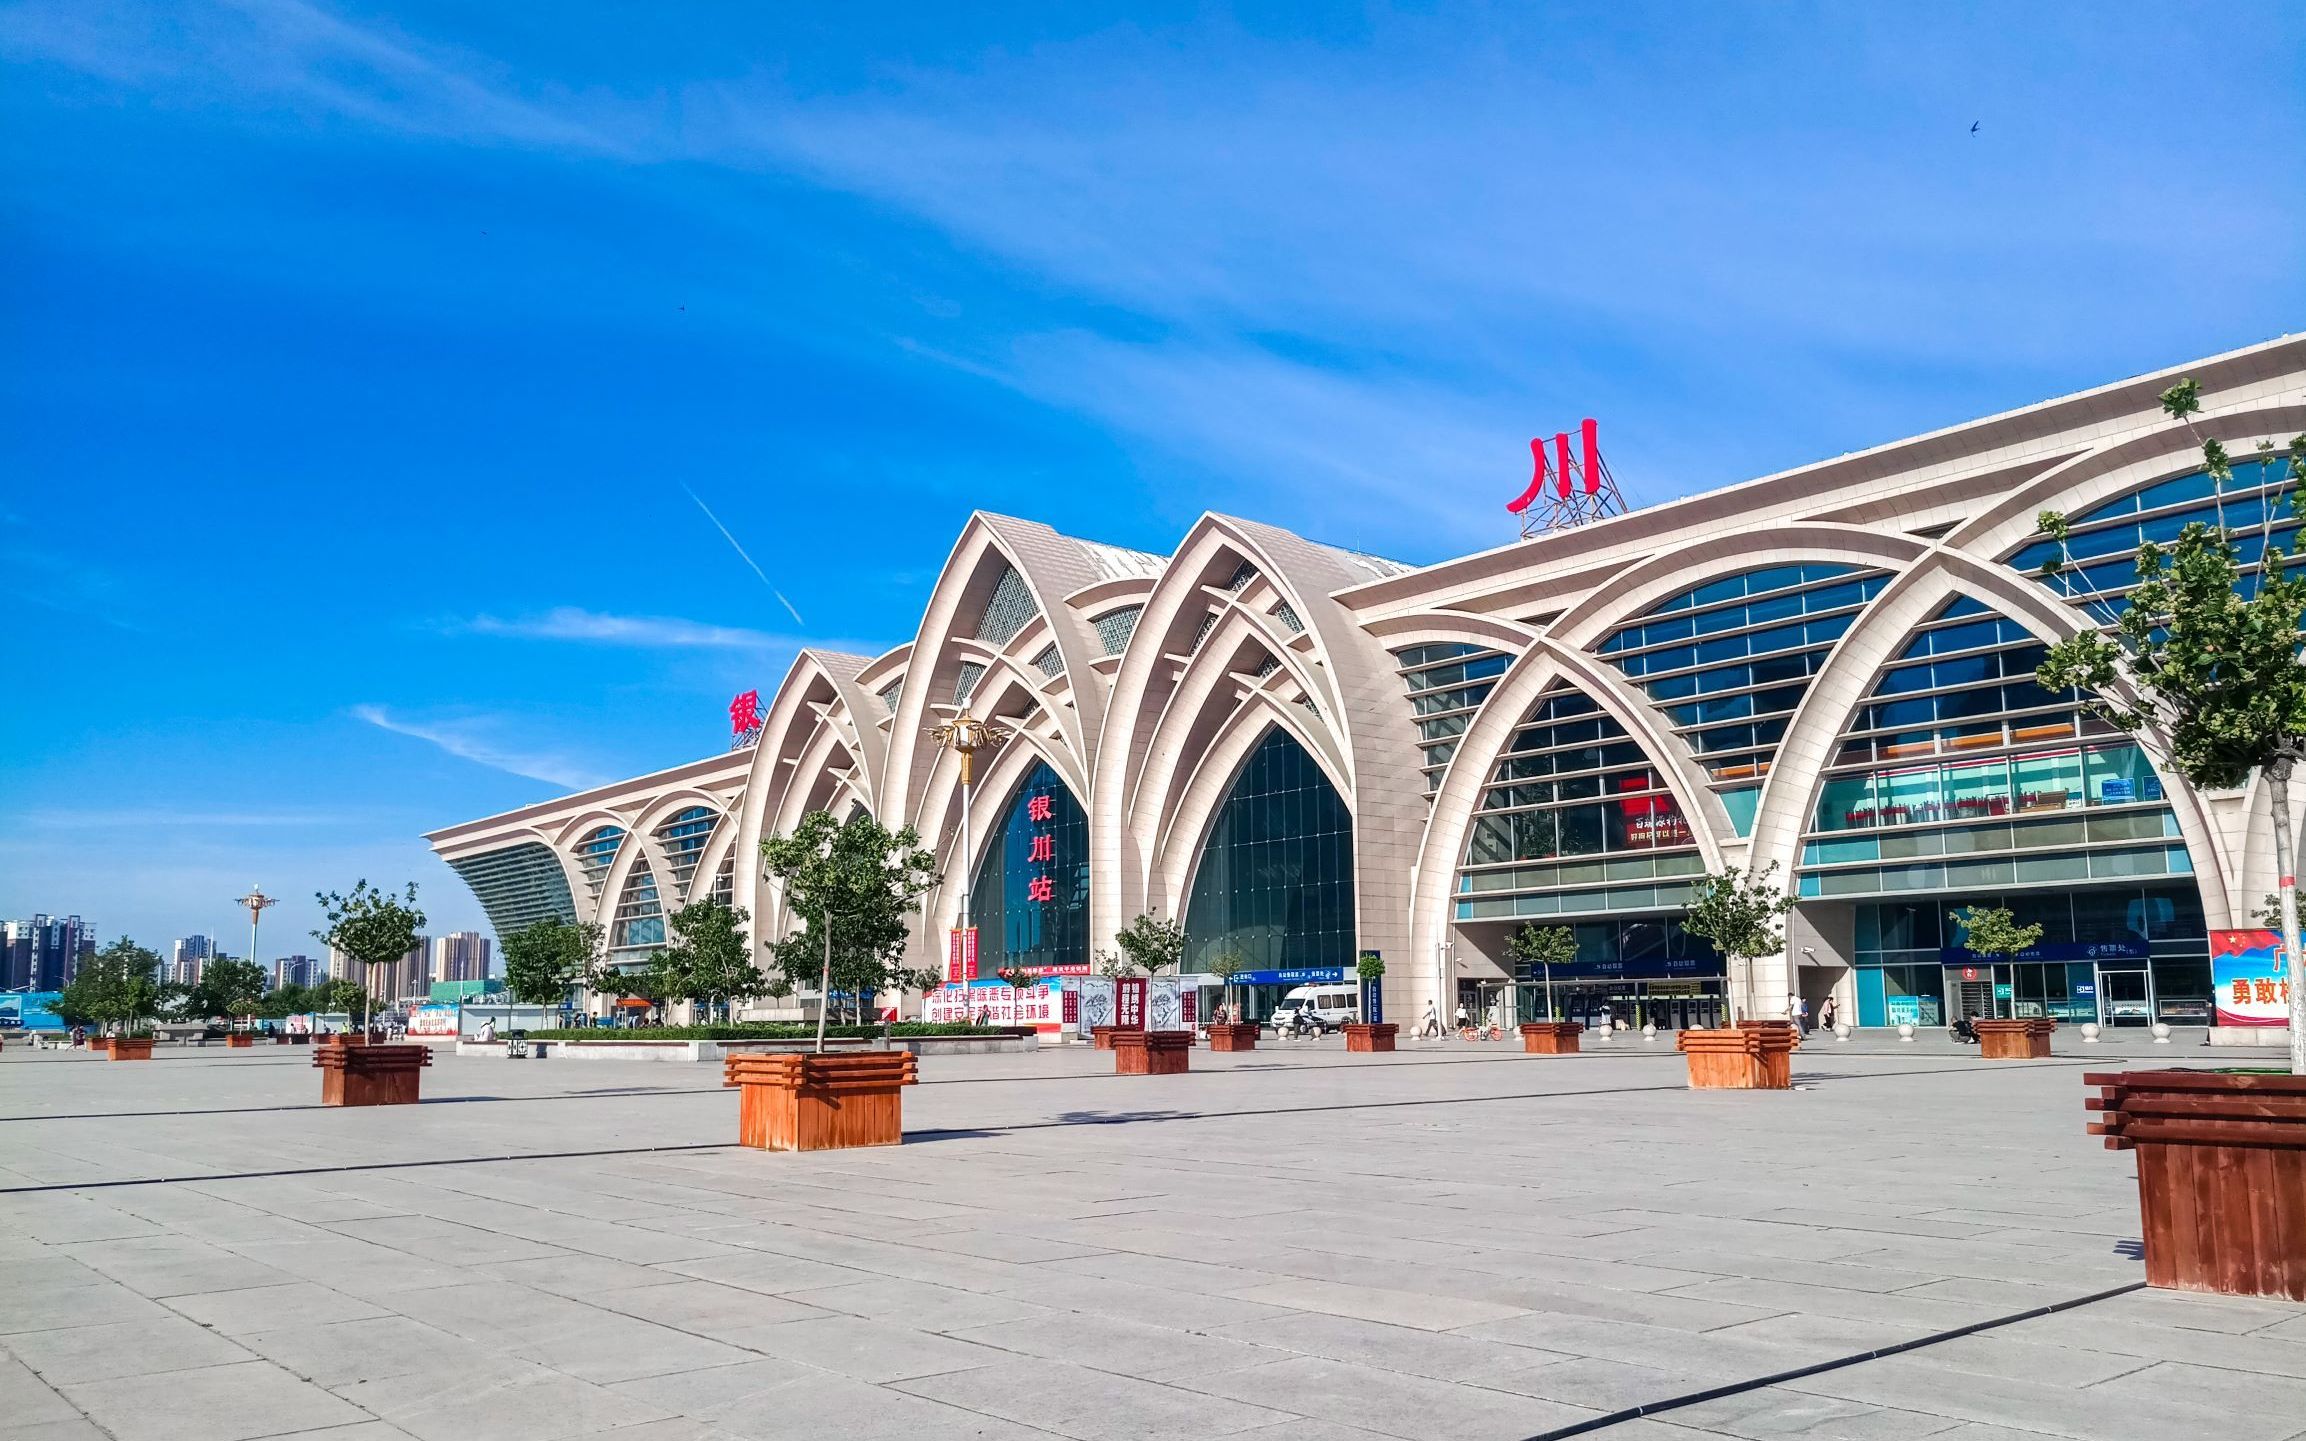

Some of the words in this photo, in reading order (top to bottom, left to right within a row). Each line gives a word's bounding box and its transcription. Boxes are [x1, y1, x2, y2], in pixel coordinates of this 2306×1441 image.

[1506, 418, 1600, 512] 川
[729, 689, 761, 734] 银
[1027, 795, 1052, 902] 银川站
